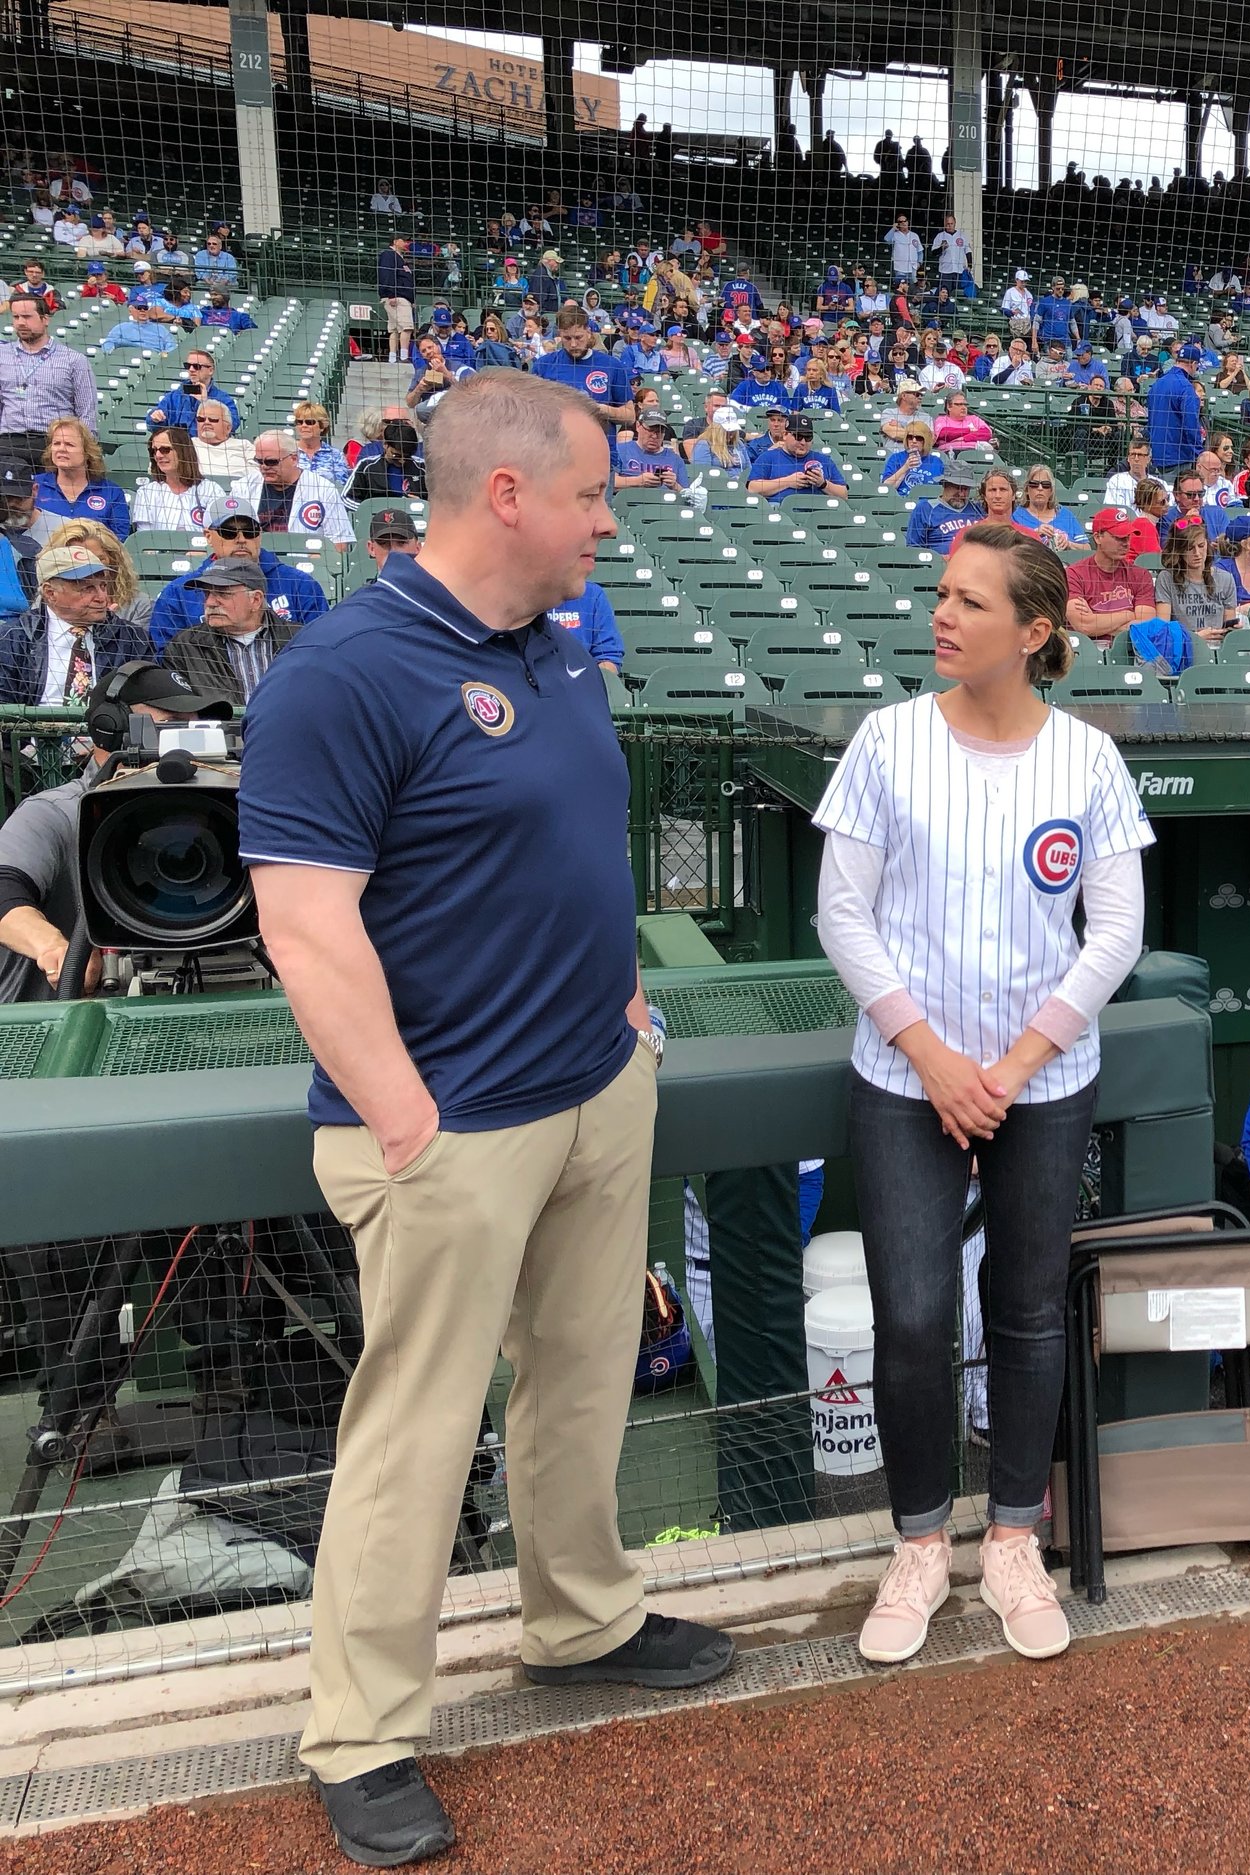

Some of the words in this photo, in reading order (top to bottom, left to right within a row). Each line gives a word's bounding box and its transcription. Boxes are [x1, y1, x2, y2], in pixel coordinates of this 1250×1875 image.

[240, 52, 262, 70] 212
[959, 124, 977, 140] 210
[730, 291, 749, 306] 30
[752, 393, 778, 404] CHICAGO
[803, 395, 829, 405] CHICAGO
[801, 418, 808, 426] C
[939, 519, 979, 535] CHICA
[73, 550, 88, 561] C
[1186, 605, 1217, 616] CRYING
[1196, 617, 1205, 628] IN
[1138, 772, 1194, 795] Farm
